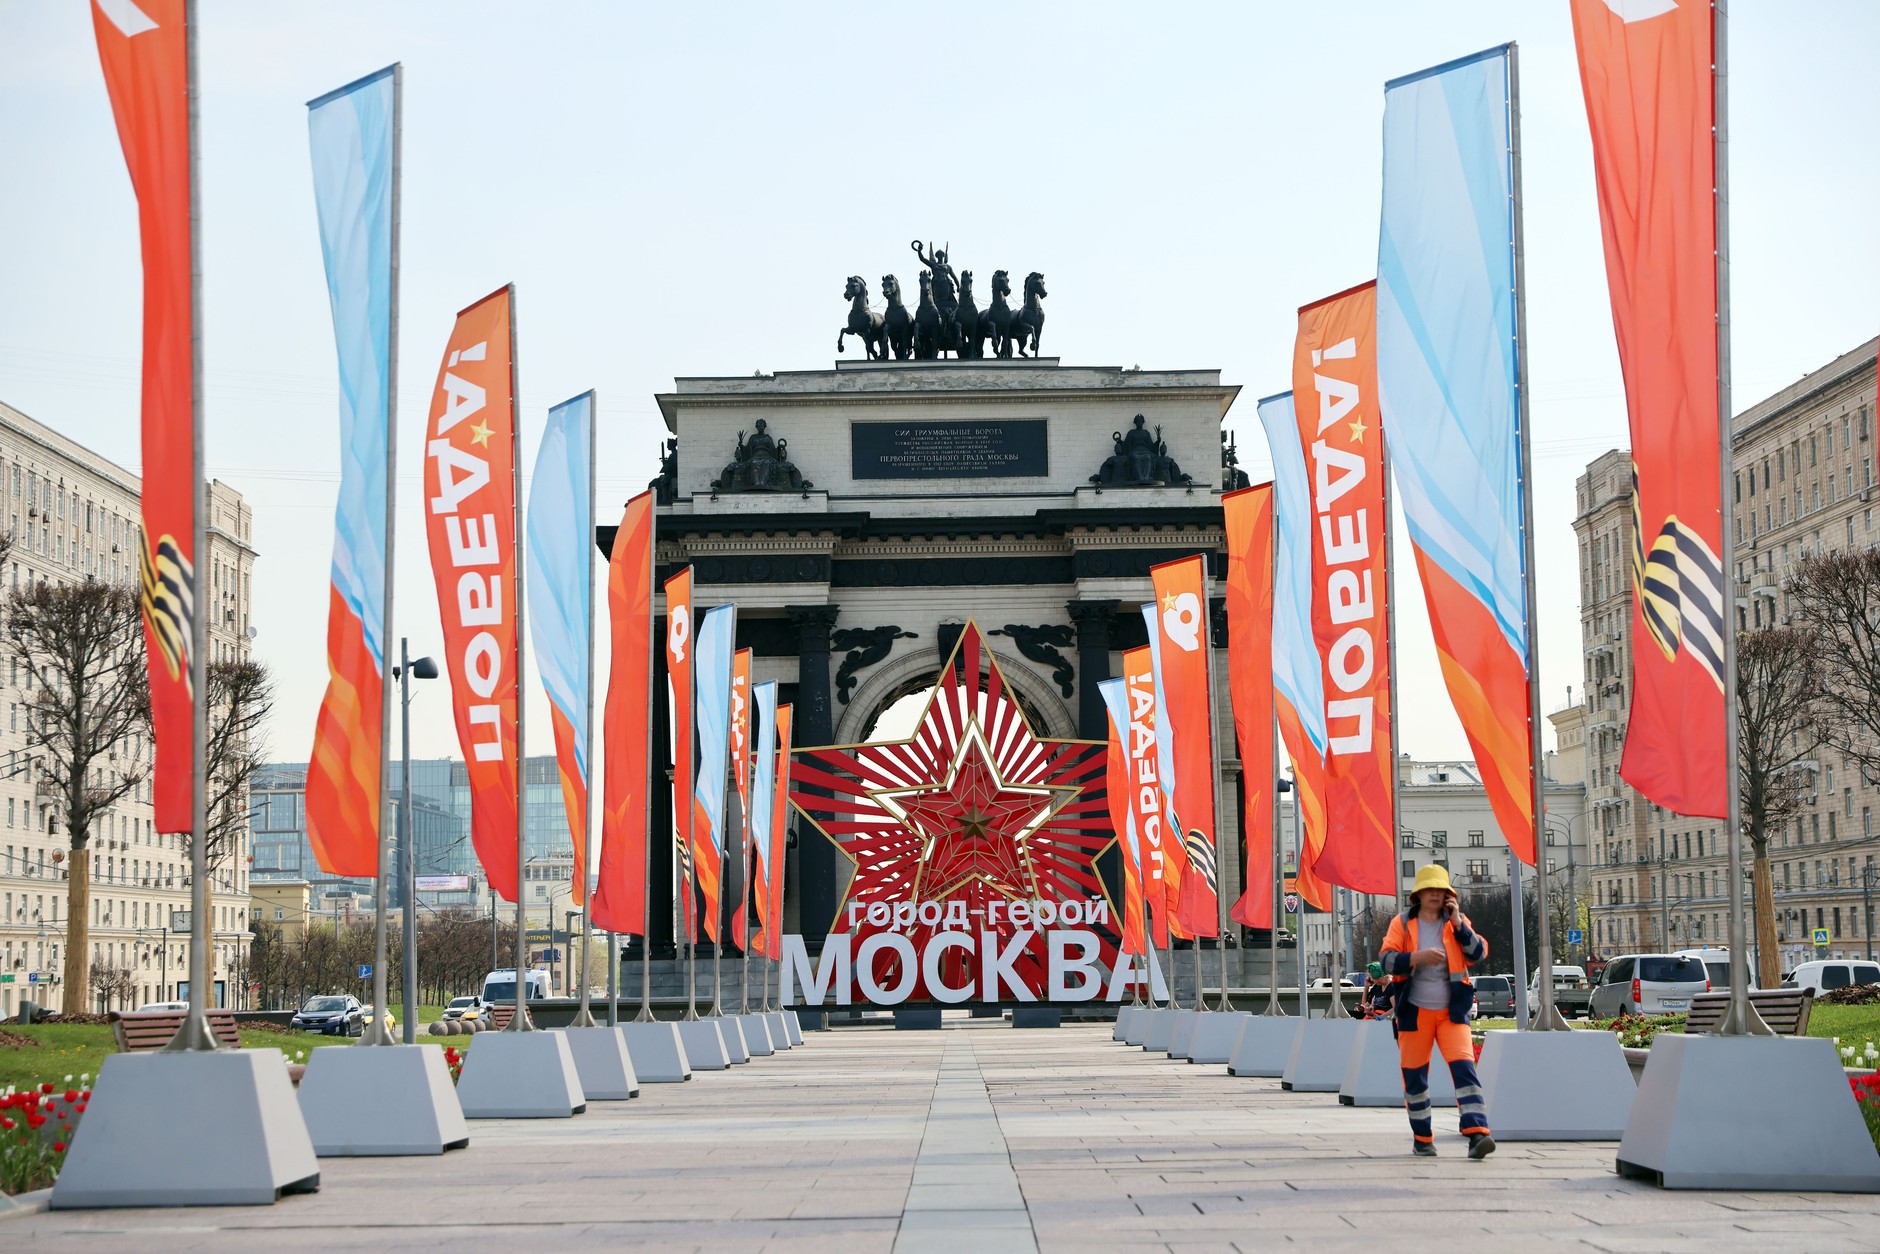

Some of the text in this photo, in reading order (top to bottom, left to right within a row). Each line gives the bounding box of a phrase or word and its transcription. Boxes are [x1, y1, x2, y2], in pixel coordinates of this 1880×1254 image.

[894, 429, 911, 437] СИИ
[915, 428, 971, 436] ТРИУМФАЛЬНЫЕ
[879, 453, 1019, 462] ПЕРВОПРЕСТОЛЬНОГО ГРАДА МОСКВЫ
[848, 894, 1109, 931] город-герой
[781, 929, 1170, 1005] МОСКВА
